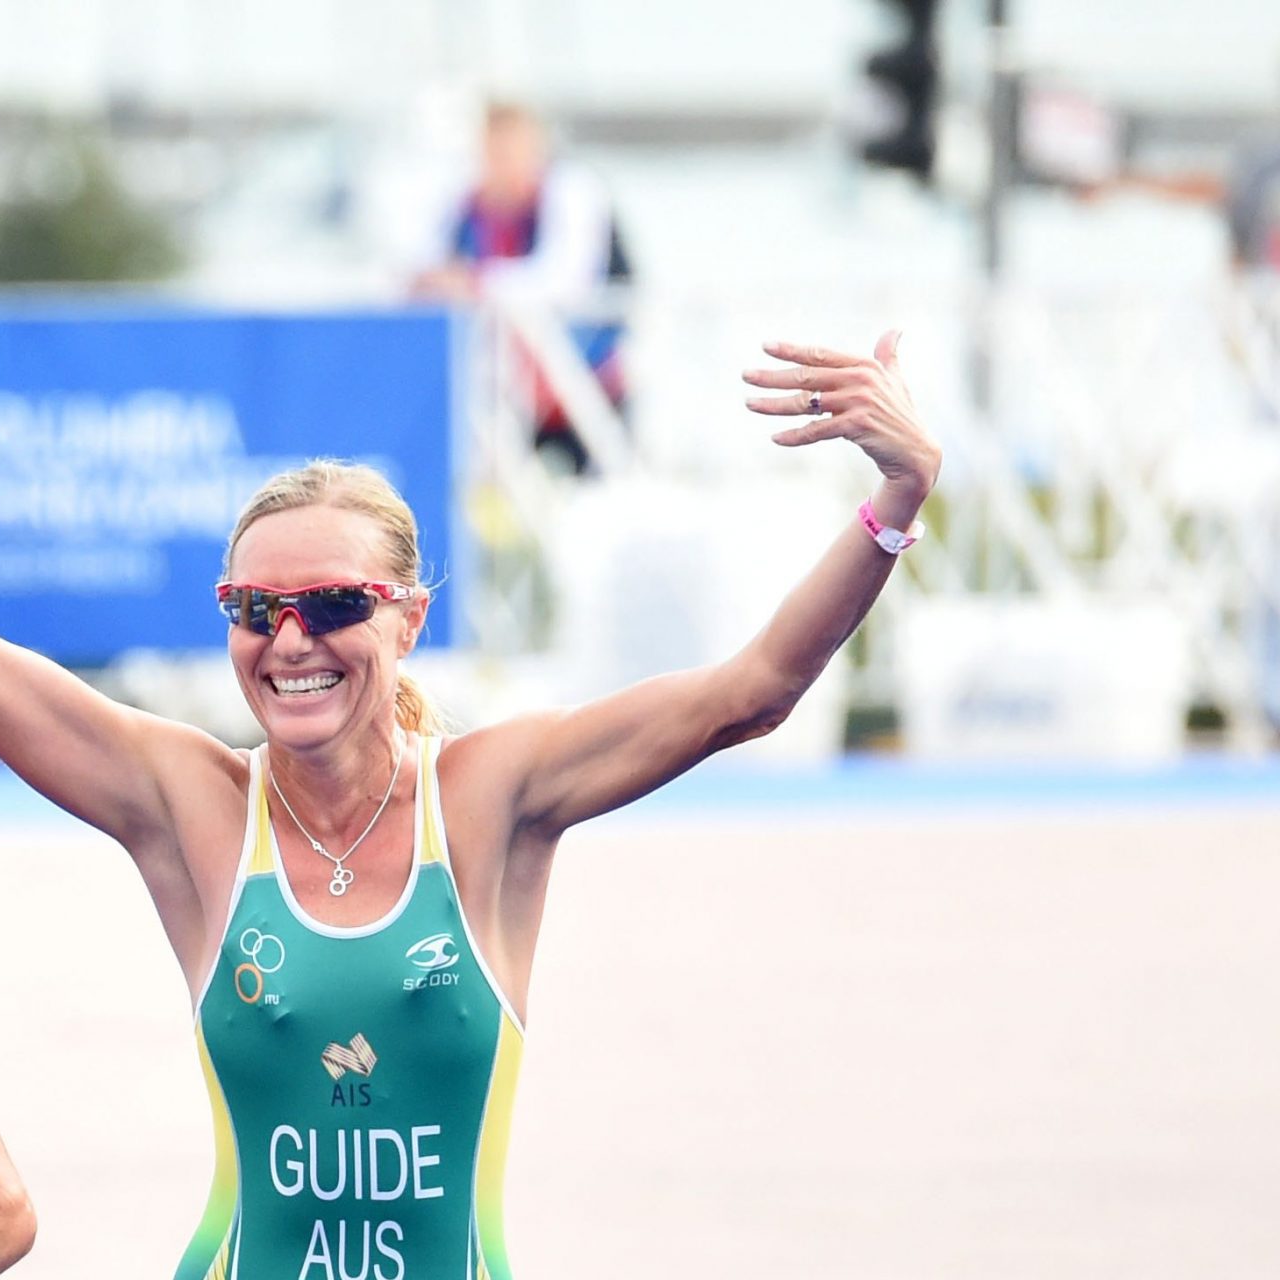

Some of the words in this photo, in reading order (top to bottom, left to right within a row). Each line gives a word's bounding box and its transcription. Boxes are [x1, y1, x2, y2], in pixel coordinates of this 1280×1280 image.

[402, 973, 460, 991] SCODY
[265, 994, 280, 1005] ITU
[331, 1083, 372, 1107] AIS
[269, 1124, 445, 1201] GUIDE
